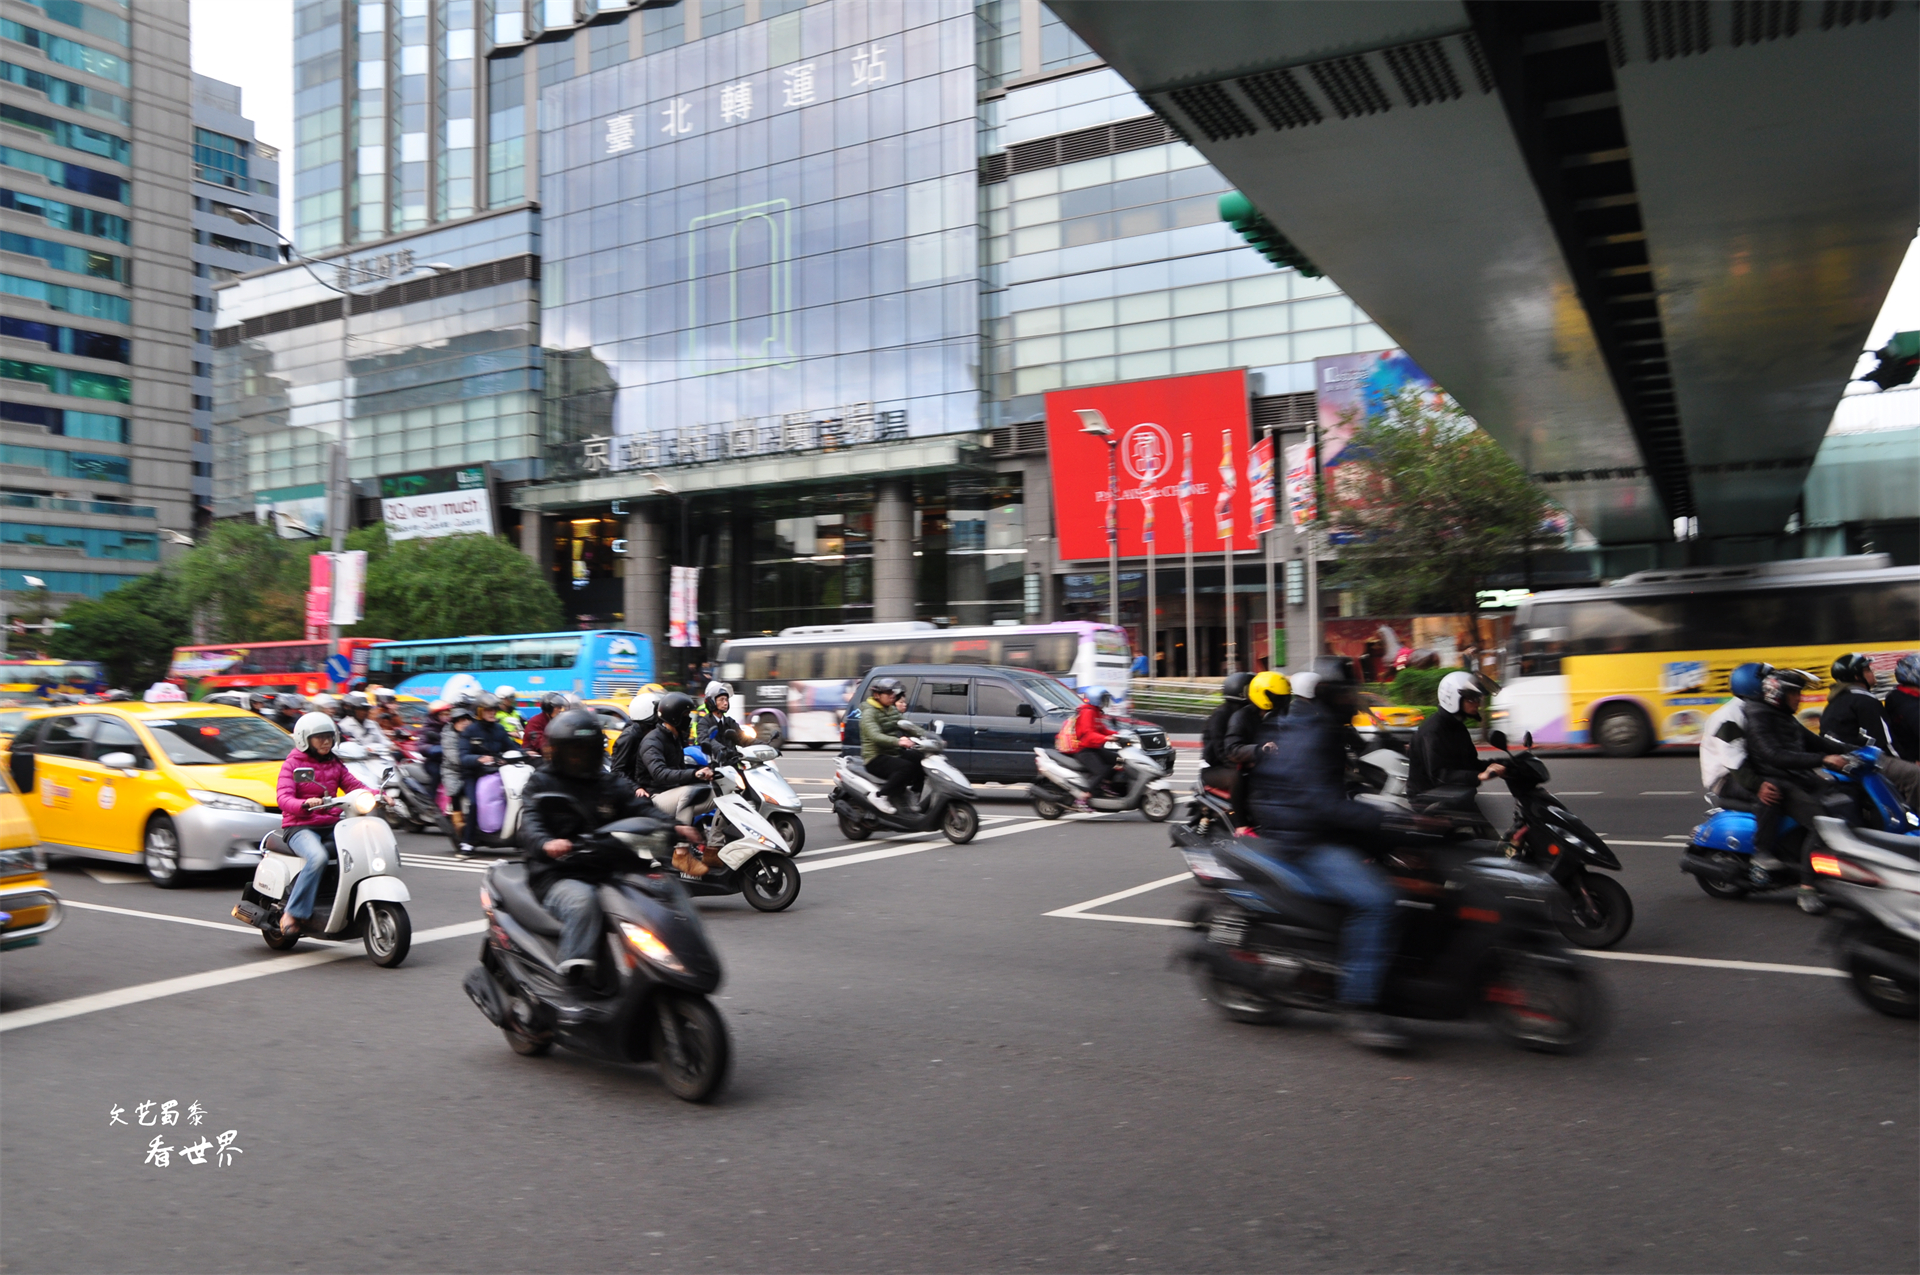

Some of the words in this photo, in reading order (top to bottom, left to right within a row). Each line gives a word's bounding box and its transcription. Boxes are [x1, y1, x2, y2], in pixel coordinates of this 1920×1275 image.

[605, 45, 888, 154] 臺北轉運站
[1162, 483, 1209, 497] CHNE
[408, 503, 437, 521] very
